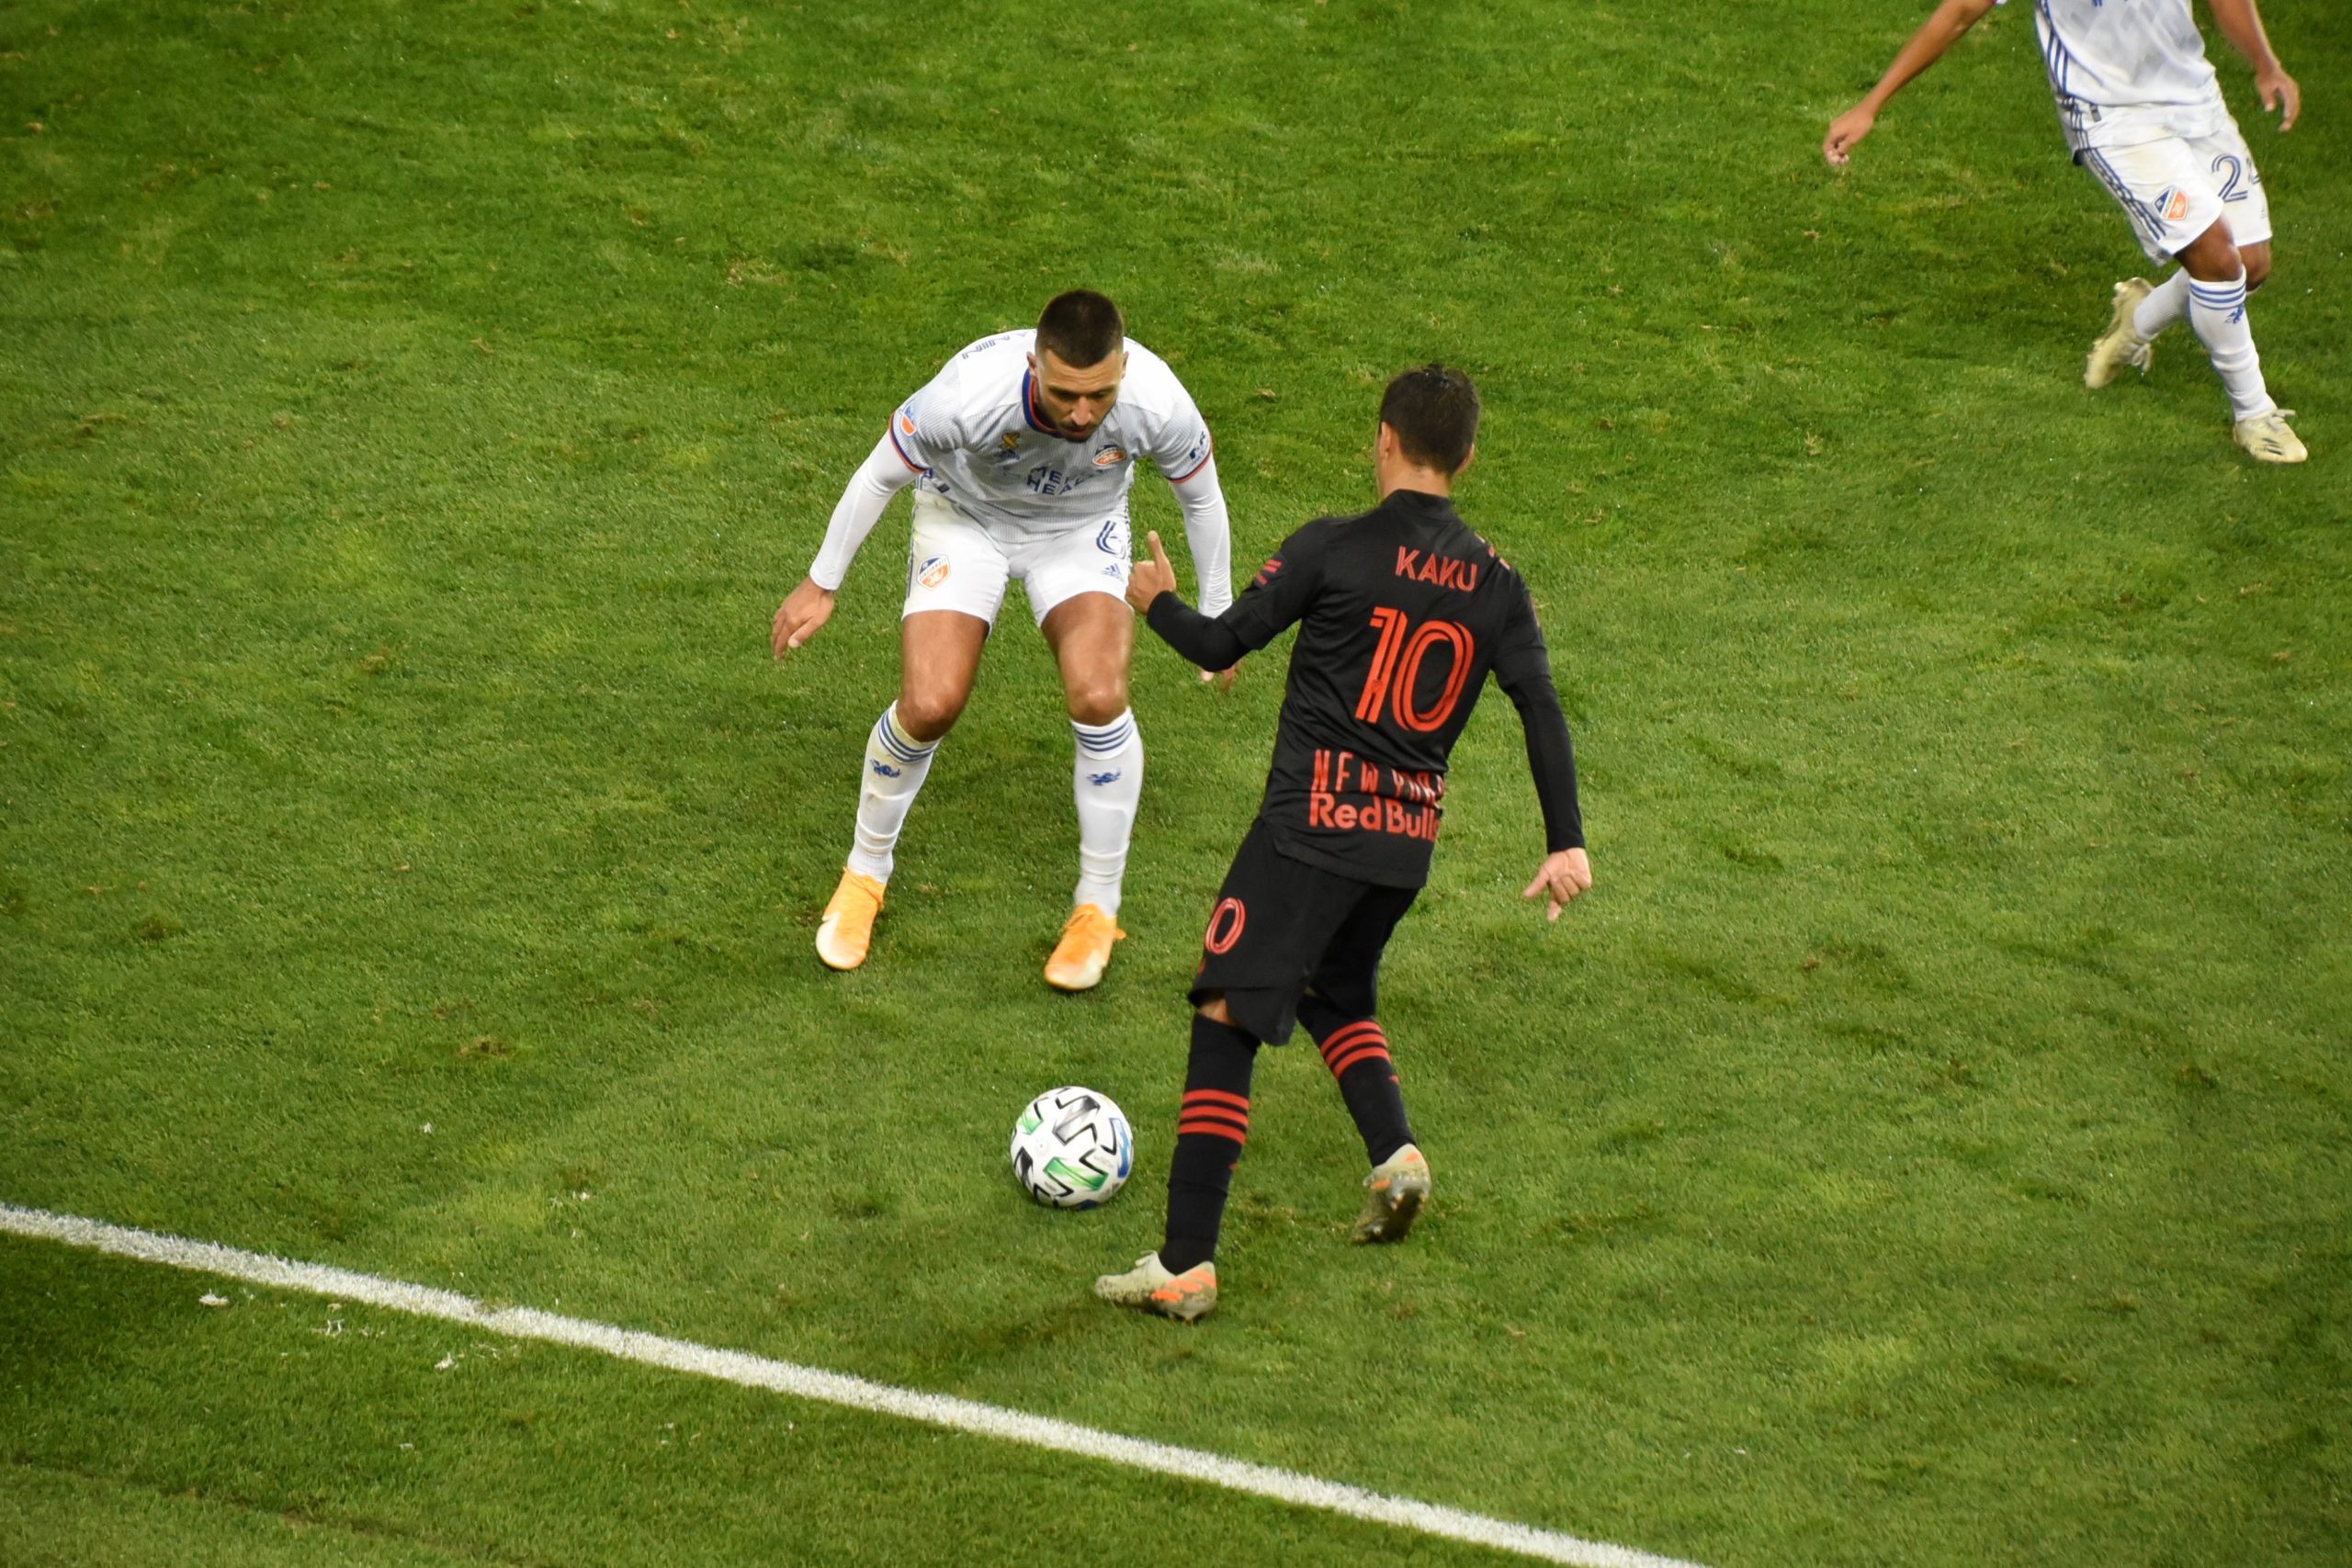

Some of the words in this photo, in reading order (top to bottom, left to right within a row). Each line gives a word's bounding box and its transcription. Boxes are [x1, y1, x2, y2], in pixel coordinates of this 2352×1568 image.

[1395, 546, 1478, 592] KAKU
[1355, 606, 1475, 733] 10
[1308, 792, 1382, 830] Red
